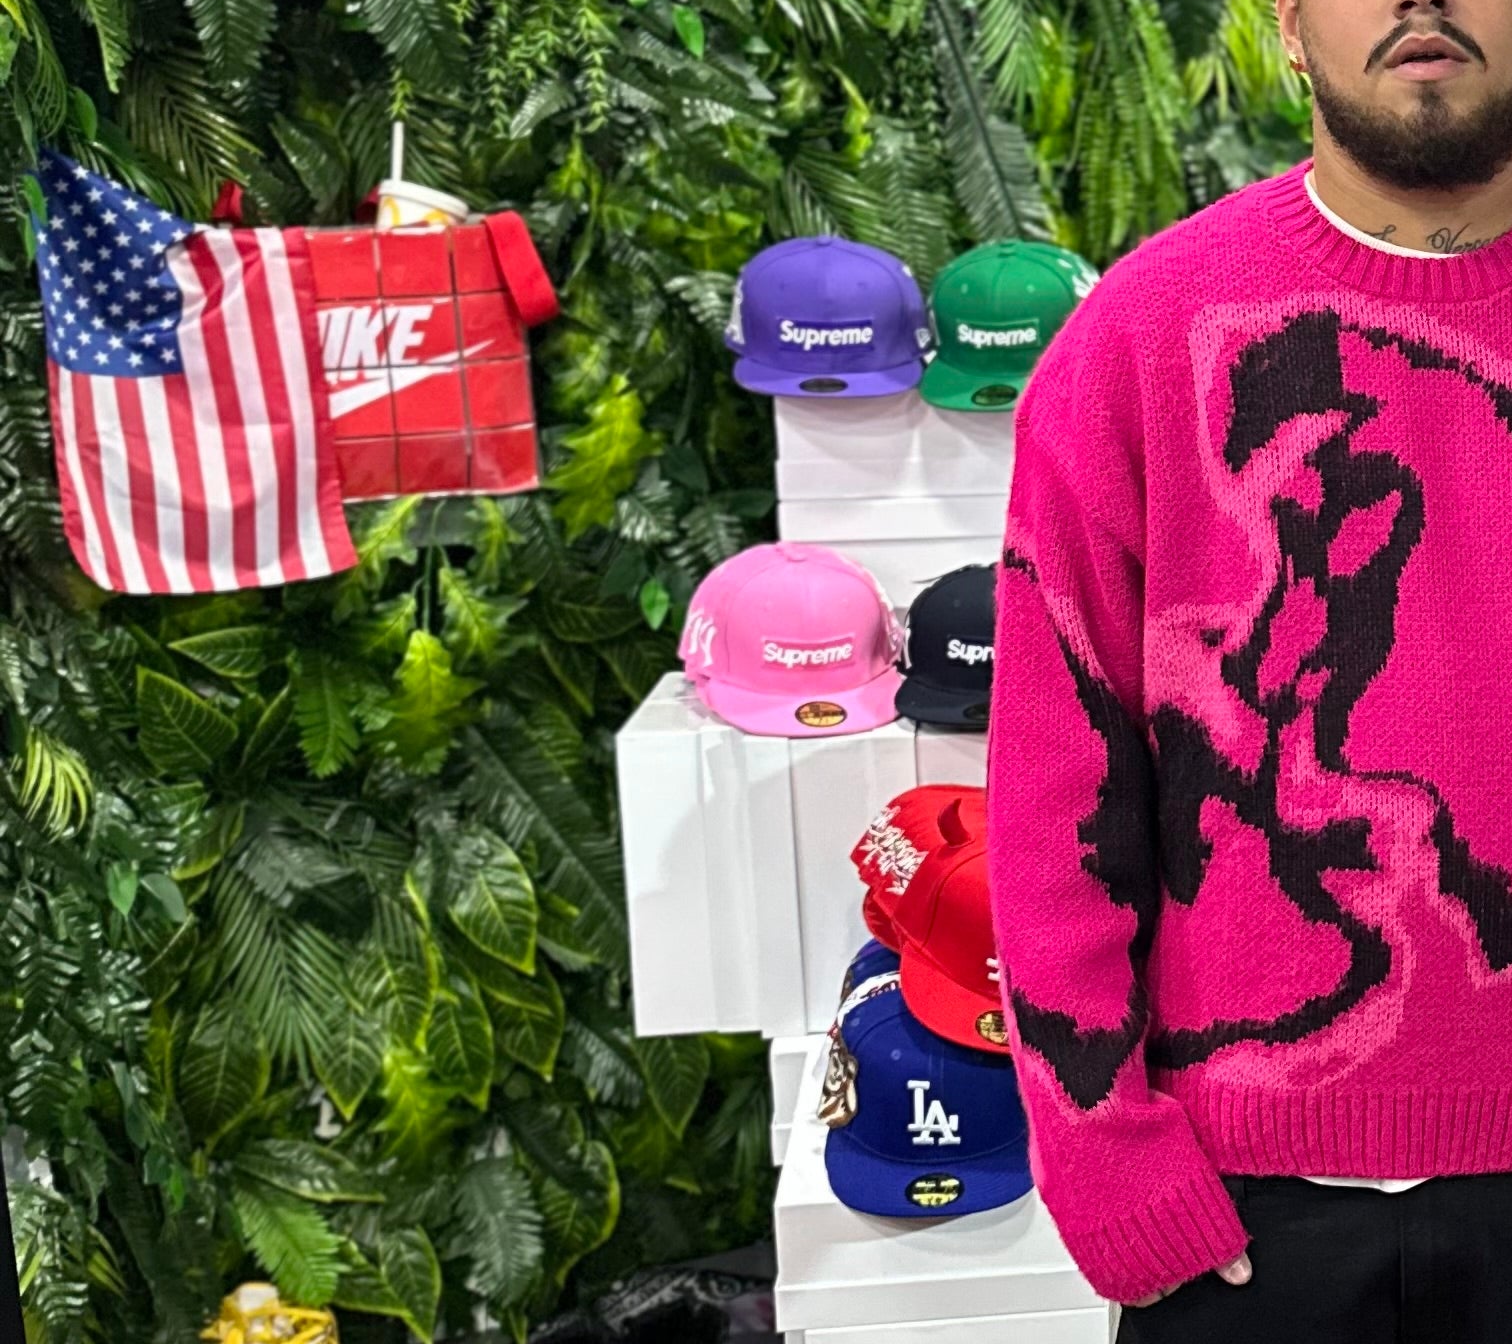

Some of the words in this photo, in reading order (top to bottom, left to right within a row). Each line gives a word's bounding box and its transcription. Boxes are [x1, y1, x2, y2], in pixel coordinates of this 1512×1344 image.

[316, 304, 434, 385] IKE
[779, 319, 874, 352] Supreme
[956, 323, 1038, 349] Supreme
[763, 641, 854, 669] Supreme
[945, 638, 996, 666] Supr
[906, 1079, 962, 1145] LA
